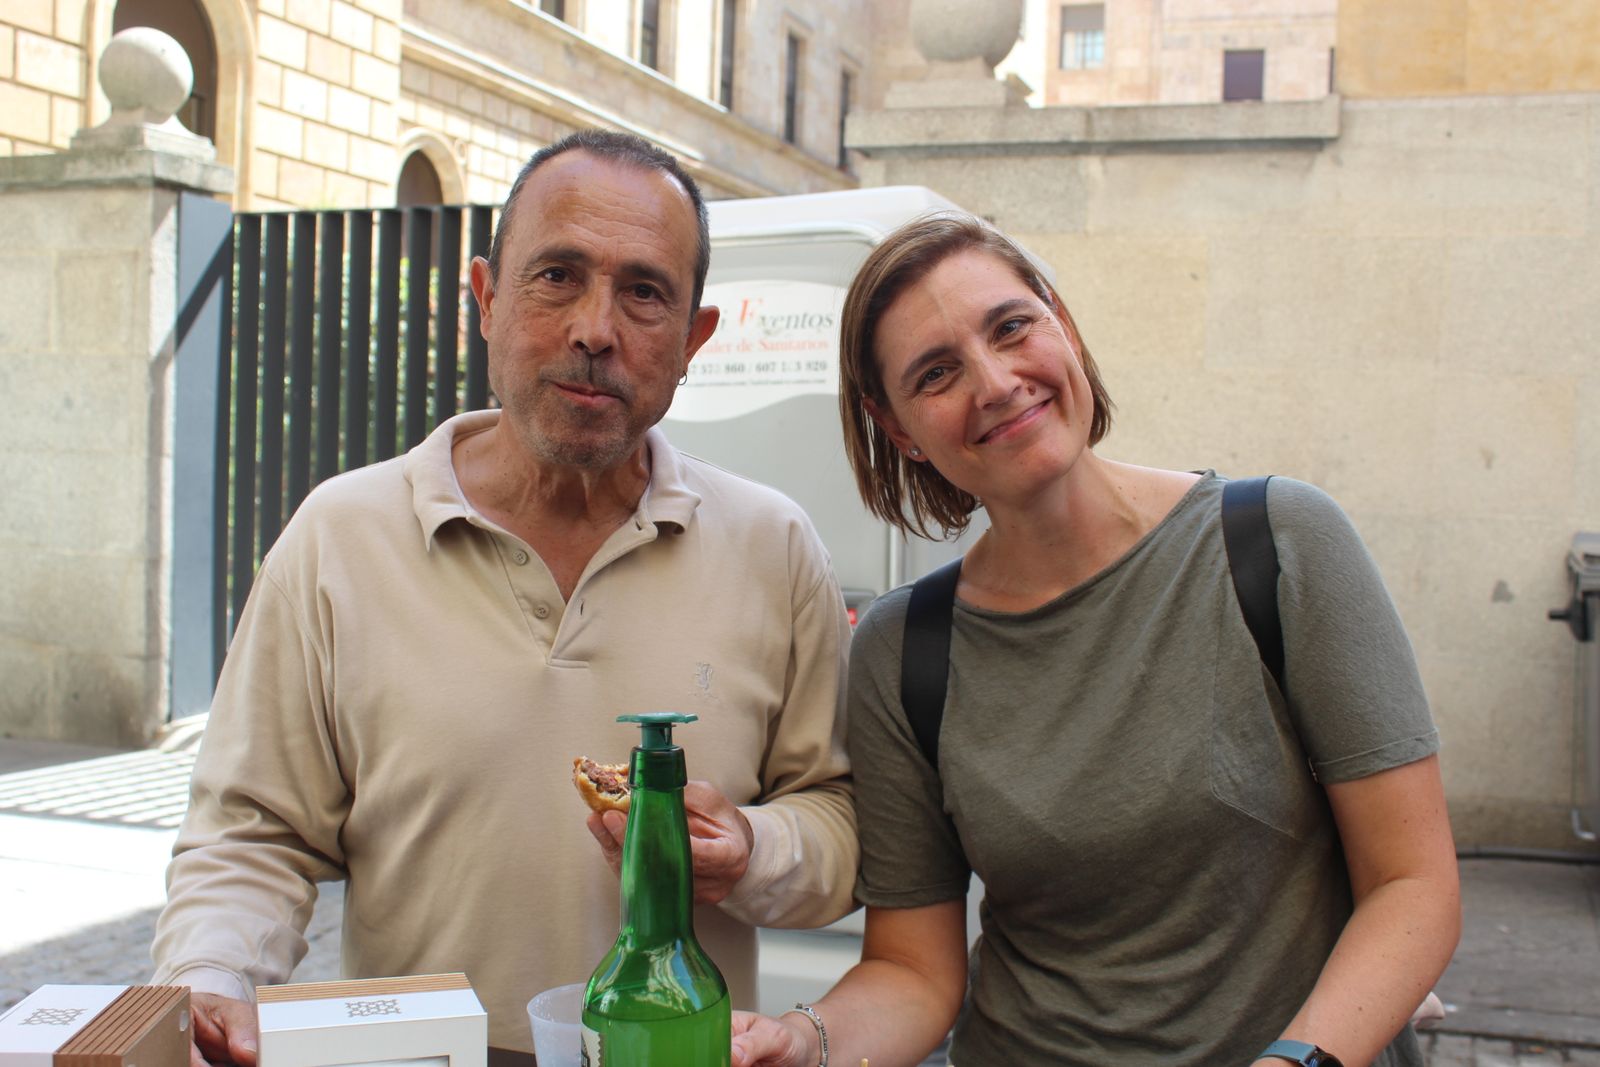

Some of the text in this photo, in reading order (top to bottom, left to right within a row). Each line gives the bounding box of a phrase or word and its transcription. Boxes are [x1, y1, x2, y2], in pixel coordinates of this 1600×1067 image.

[738, 298, 834, 335] Eventos
[736, 339, 753, 353] de
[759, 338, 829, 352] Sanitarios
